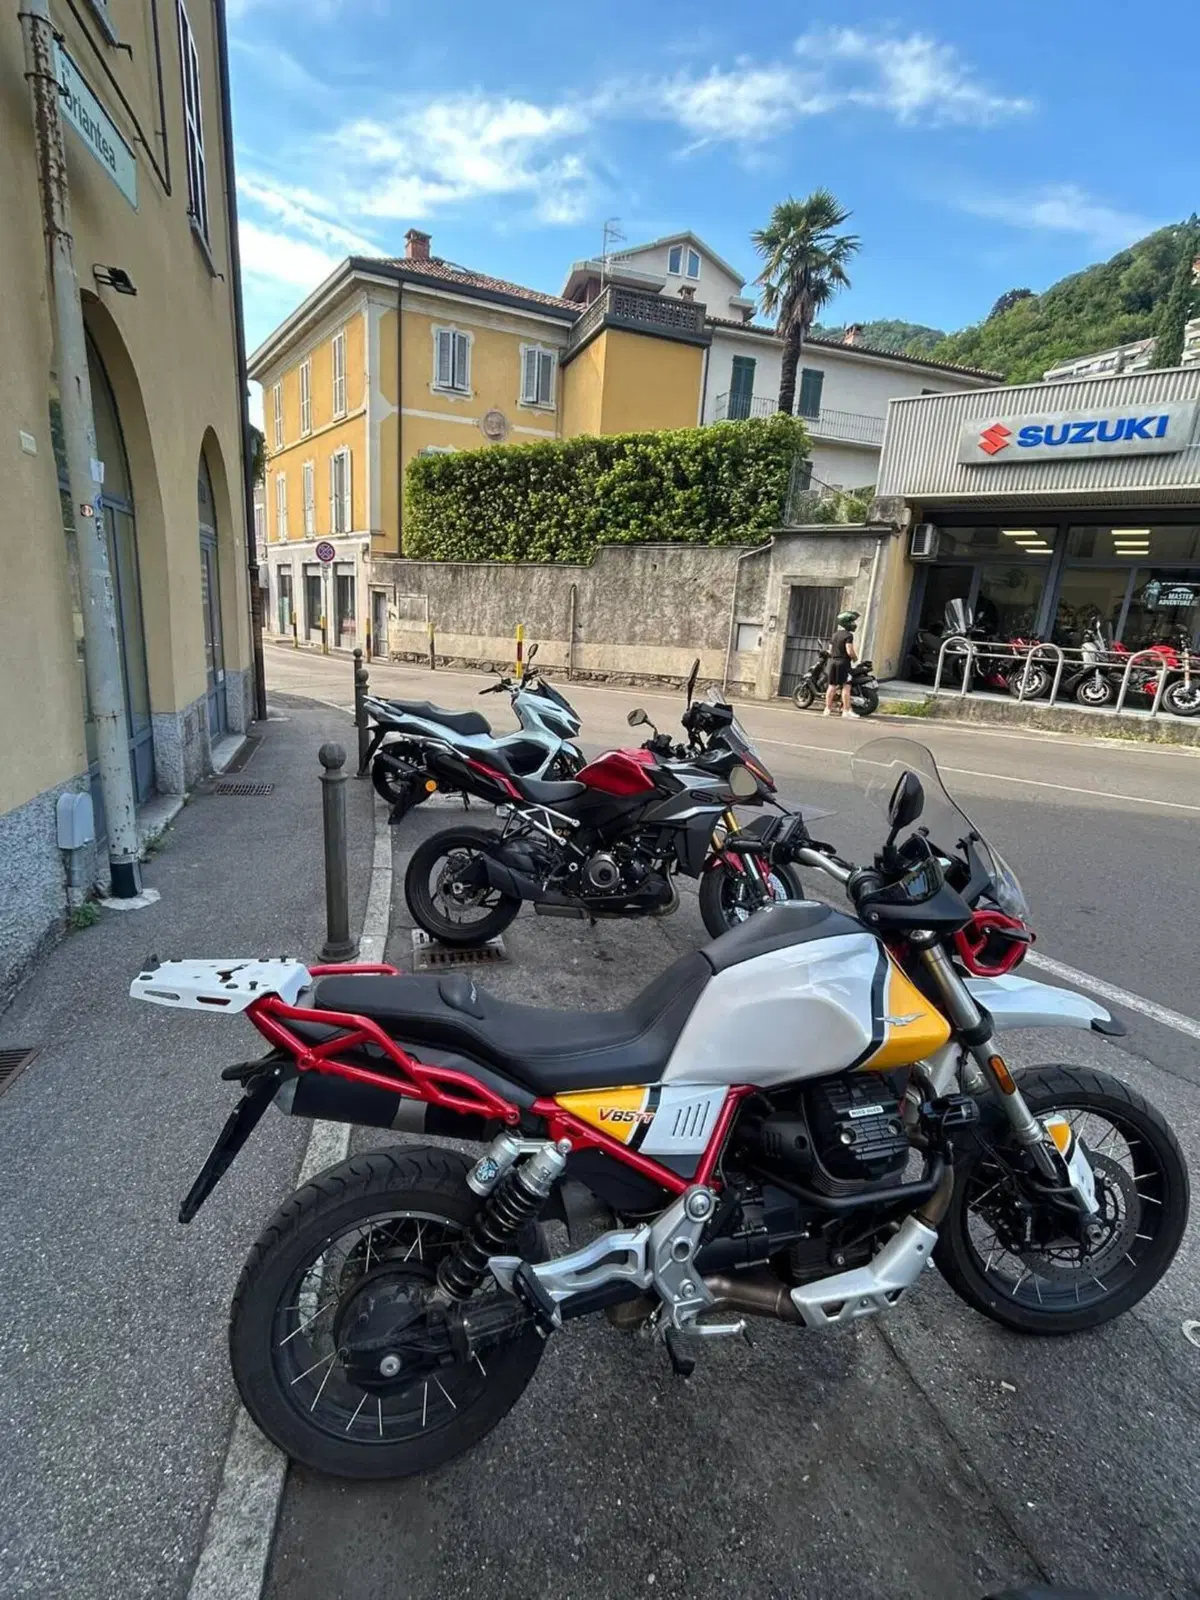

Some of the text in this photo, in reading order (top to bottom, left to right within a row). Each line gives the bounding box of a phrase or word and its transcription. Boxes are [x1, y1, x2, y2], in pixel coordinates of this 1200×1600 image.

[1017, 415, 1169, 447] SUZUKI
[1168, 592, 1194, 600] MASTER
[599, 1108, 655, 1123] V85TT
